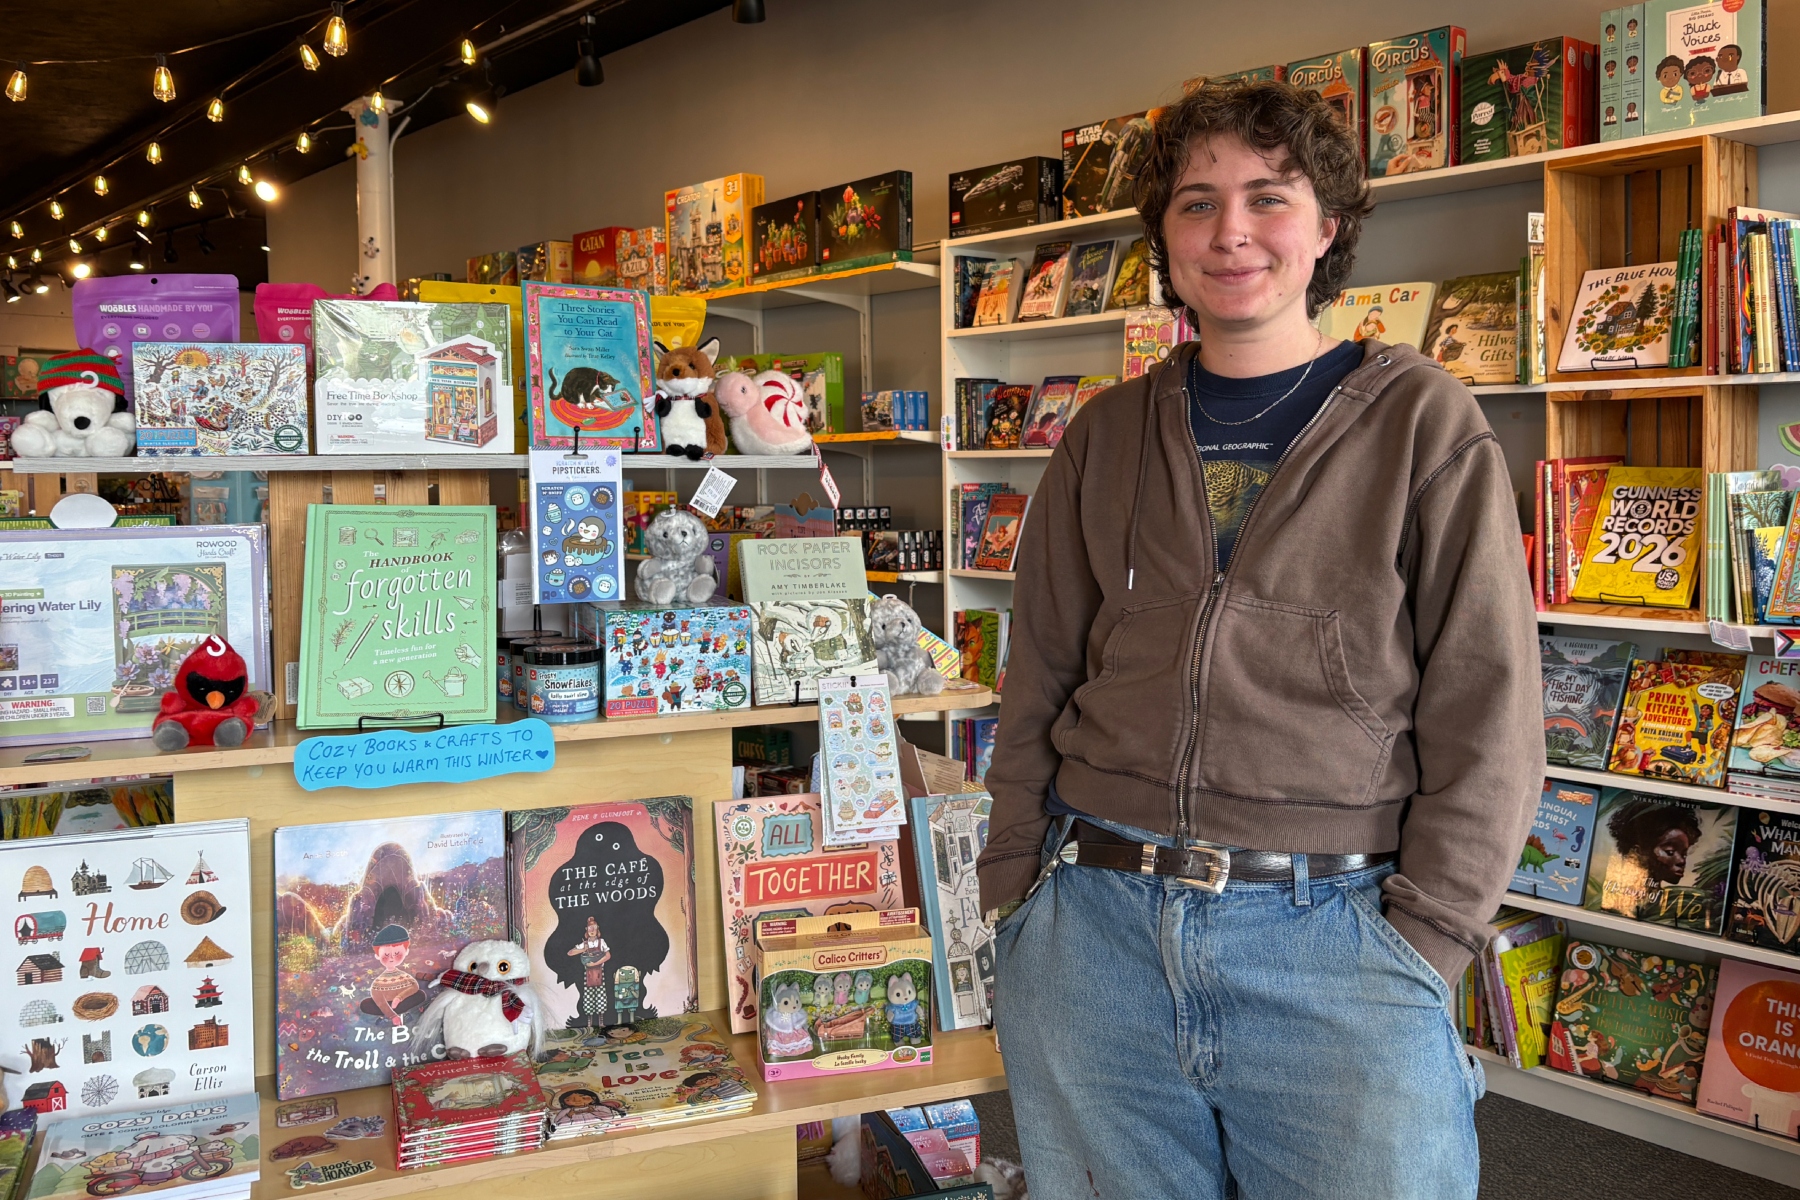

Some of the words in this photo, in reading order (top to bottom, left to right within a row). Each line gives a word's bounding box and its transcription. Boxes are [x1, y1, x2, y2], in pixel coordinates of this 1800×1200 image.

[1683, 19, 1721, 36] Black
[1681, 33, 1721, 47] Voices
[1372, 38, 1430, 73] CIRCUS
[1290, 59, 1342, 87] CIRCUS
[1473, 108, 1494, 120] Parrot
[1079, 124, 1102, 136] STAR
[1076, 133, 1100, 146] WARS
[677, 192, 700, 205] CREATOR
[580, 234, 605, 252] CATAN
[625, 260, 644, 272] AZUL
[1587, 276, 1611, 292] THE
[1614, 270, 1646, 284] BLUE
[1650, 267, 1677, 278] HOU
[1333, 290, 1381, 307] Mama
[1389, 288, 1419, 304] Car
[138, 304, 182, 312] HANDMADE
[185, 304, 196, 312] BY
[198, 304, 213, 312] YOU
[559, 303, 584, 312] Three
[588, 304, 615, 314] Stories
[558, 315, 574, 324] You
[576, 316, 594, 324] Can
[596, 316, 618, 326] Read
[575, 328, 596, 336] Your
[598, 329, 613, 338] Cat
[1477, 333, 1516, 347] Hilwa
[1480, 348, 1515, 362] Gifts
[327, 390, 348, 400] Free
[348, 390, 370, 400] Time
[372, 390, 418, 402] Bookshop
[158, 431, 193, 440] PUZZLE
[1613, 486, 1702, 500] GUINNESS
[1610, 500, 1700, 519] WORLD
[1601, 516, 1696, 534] RECORDS
[196, 540, 237, 548] ROWOOD
[757, 543, 798, 556] ROCK
[802, 542, 851, 554] PAPER
[26, 552, 42, 562] Lily
[197, 549, 216, 558] Hands
[363, 550, 380, 558] The
[1592, 533, 1687, 573] 2026
[368, 552, 454, 569] HANDBOOK
[770, 558, 842, 570] INCISORS
[1658, 571, 1678, 582] USA
[332, 568, 471, 615] forgotten
[792, 582, 847, 590] TIMBERLAKE
[38, 601, 76, 612] Water
[79, 600, 102, 612] Lily
[382, 599, 456, 640] skills
[374, 647, 409, 656] Timeless
[410, 644, 424, 655] fun
[425, 643, 436, 652] for
[986, 621, 998, 680] WARRIORS
[1569, 642, 1598, 650] BEGINNER'S
[396, 652, 437, 664] generation
[1759, 660, 1800, 676] CHEF
[540, 672, 556, 680] Frosty
[1566, 674, 1578, 683] MY
[544, 679, 592, 690] Snowflakes
[1549, 679, 1573, 692] FIRST
[1575, 684, 1592, 693] DAY
[1550, 690, 1584, 704] FISHING
[1648, 692, 1686, 705] PRIYA'S
[12, 700, 55, 709] WARNING:
[610, 702, 621, 710] 20
[626, 700, 655, 709] PUZZLE
[1646, 702, 1689, 716] KITCHEN
[1643, 713, 1692, 726] ADVENTURES
[1658, 730, 1683, 738] KRISHNA
[308, 741, 357, 760] COZY
[364, 738, 417, 756] BOOKS
[424, 740, 432, 748] &
[436, 731, 502, 749] CRAFTS
[506, 729, 533, 742] TO
[738, 741, 766, 760] CHESS
[302, 765, 347, 782] KEEP
[354, 762, 386, 779] YOU
[392, 759, 438, 774] WARM
[444, 756, 472, 768] THIS
[478, 749, 534, 766] WINTER
[572, 813, 589, 822] RENE
[600, 810, 633, 818] GLUMFOOT
[1540, 801, 1577, 821] LINGUAL
[1533, 821, 1550, 830] RDS
[1545, 812, 1569, 827] FIRST
[770, 824, 805, 847] ALL
[1760, 825, 1800, 843] WHAL
[427, 840, 448, 849] David
[450, 837, 484, 846] Litchfield
[326, 850, 348, 858] Booth
[562, 865, 598, 881] THE
[605, 858, 649, 876] CAFÉ
[560, 884, 571, 892] at
[580, 879, 597, 890] the
[605, 877, 630, 888] edge
[638, 873, 650, 884] of
[750, 860, 872, 900] TOGETHER
[1642, 878, 1659, 888] The
[555, 894, 590, 910] THE
[595, 886, 657, 904] WOODS
[1648, 889, 1663, 903] of
[1660, 888, 1702, 922] We
[82, 902, 169, 936] Home
[818, 952, 846, 964] Calico
[848, 950, 880, 962] Critters
[1648, 1004, 1688, 1023] MUSIC
[1767, 998, 1800, 1018] THI
[354, 1026, 384, 1042] The
[1775, 1020, 1794, 1037] IS
[1739, 1032, 1800, 1058] ORAN
[307, 1048, 330, 1064] the
[334, 1050, 379, 1070] Troll
[385, 1056, 396, 1068] &
[403, 1050, 427, 1068] the
[602, 1048, 664, 1063] Tea
[1764, 1056, 1775, 1064] Trip
[1776, 1059, 1798, 1069] Through
[190, 1063, 227, 1076] Carson
[420, 1067, 468, 1077] Winter
[472, 1060, 509, 1069] Story
[625, 1063, 649, 1073] Is
[194, 1077, 223, 1092] Ellis
[602, 1070, 679, 1088] Love
[1707, 1099, 1723, 1107] Rachel
[1723, 1102, 1743, 1112] Poliquin
[82, 1116, 153, 1132] COZY
[162, 1106, 228, 1122] DAYS
[118, 1126, 150, 1134] COMFY
[152, 1120, 199, 1129] COLORING
[202, 1114, 228, 1122] BOOK
[954, 1123, 977, 1133] PUZZLE
[321, 1160, 352, 1173] BOOK
[323, 1162, 374, 1182] HOARDER
